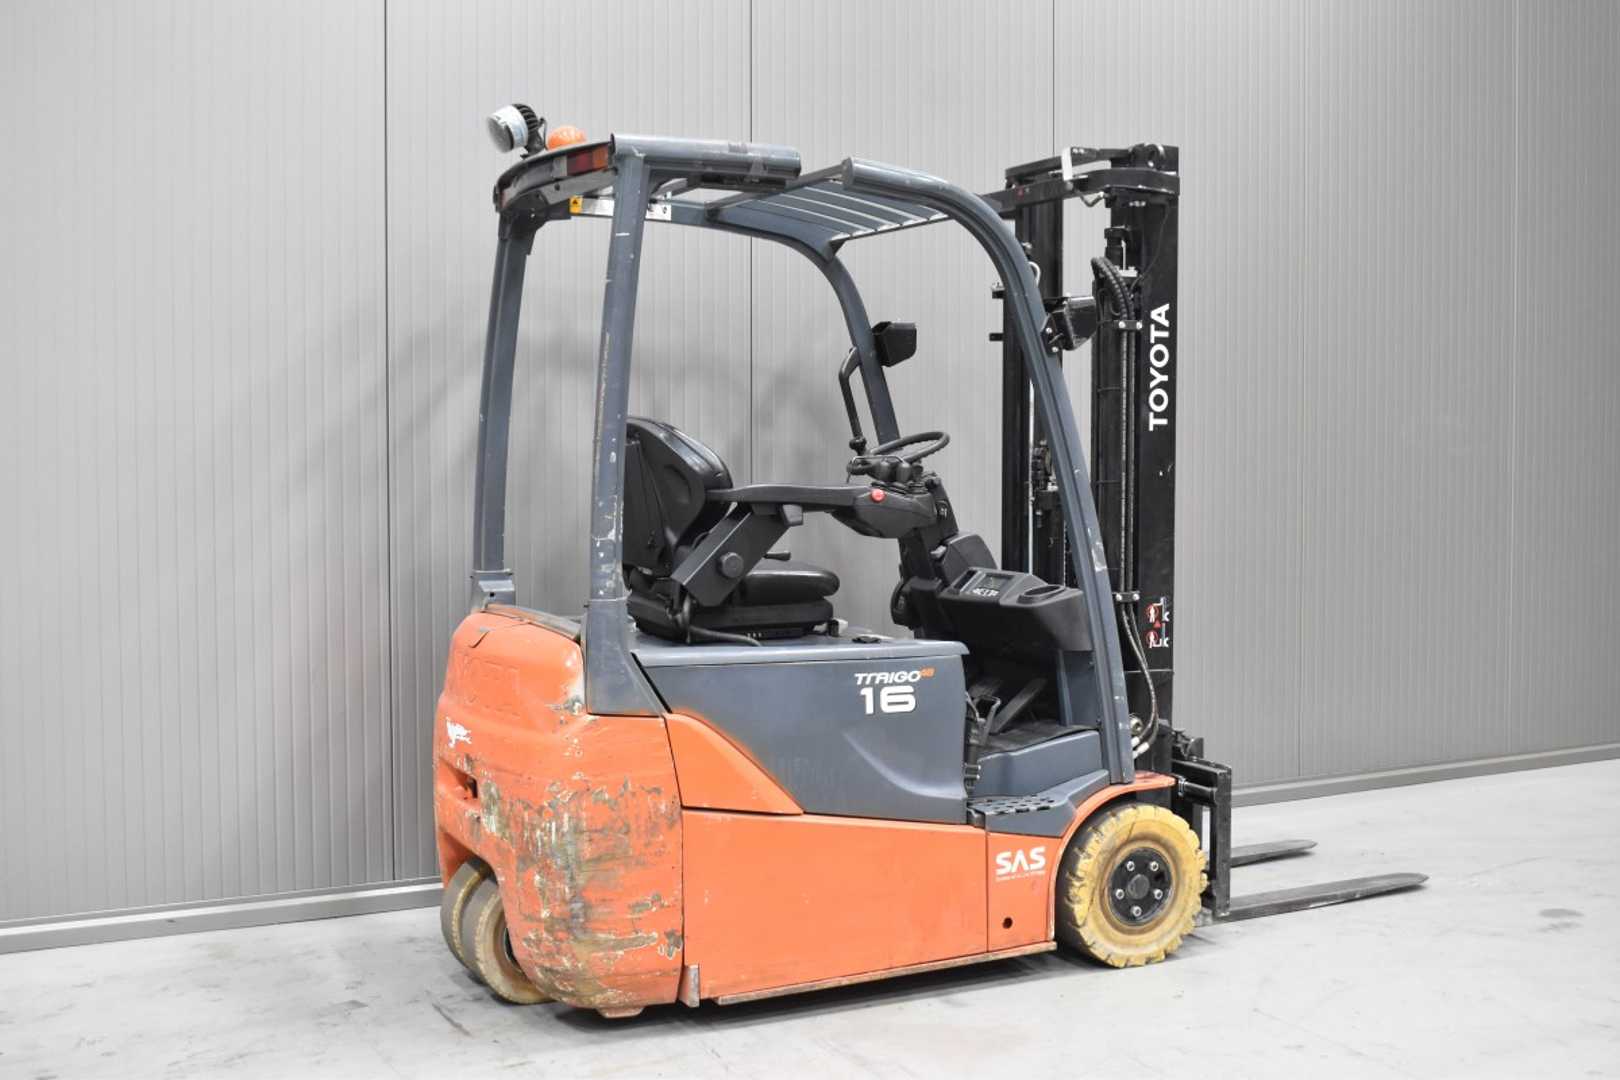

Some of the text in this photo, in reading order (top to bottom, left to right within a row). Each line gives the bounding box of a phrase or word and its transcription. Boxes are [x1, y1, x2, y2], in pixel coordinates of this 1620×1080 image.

[1149, 303, 1170, 431] TOYOTA
[860, 685, 916, 715] 16
[996, 846, 1046, 875] SAS
